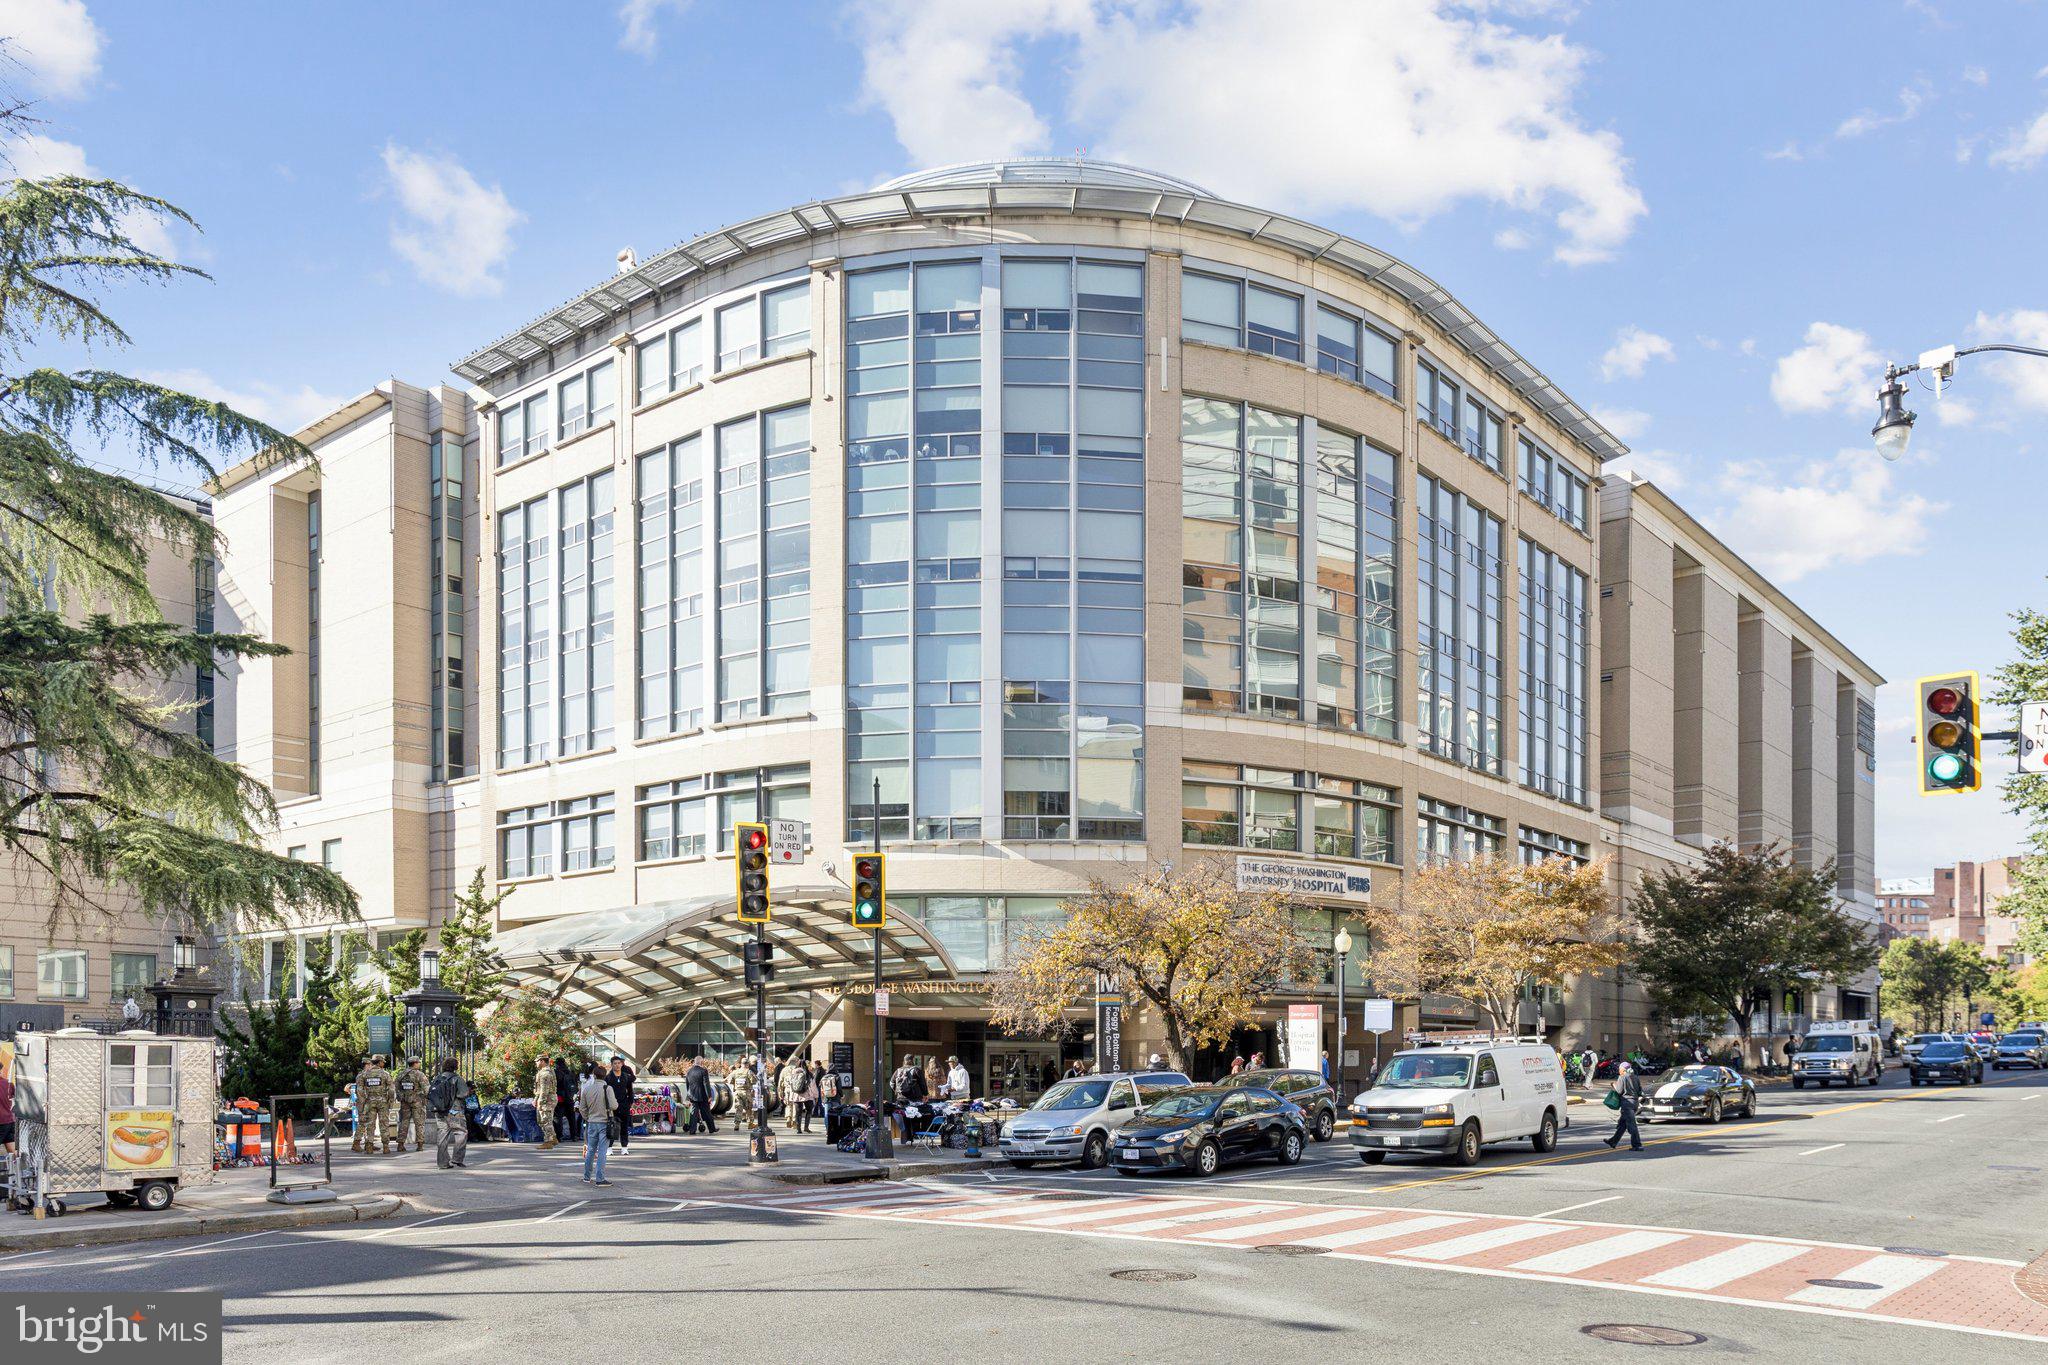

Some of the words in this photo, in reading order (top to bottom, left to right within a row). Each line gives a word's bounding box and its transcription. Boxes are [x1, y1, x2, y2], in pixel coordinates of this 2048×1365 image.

[2041, 708, 2048, 720] N
[2035, 725, 2048, 734] TU
[2026, 739, 2044, 750] ON
[780, 823, 795, 832] NO
[779, 833, 797, 841] TURN
[1242, 862, 1260, 872] THE
[1261, 864, 1295, 875] GEORGE
[1296, 867, 1347, 880] WASHINGTON
[1293, 878, 1346, 894] HOSPITAL
[1347, 876, 1370, 893] UHS
[847, 982, 899, 995] GEOGE
[1101, 974, 1120, 993] M
[1111, 1006, 1120, 1032] Foggy
